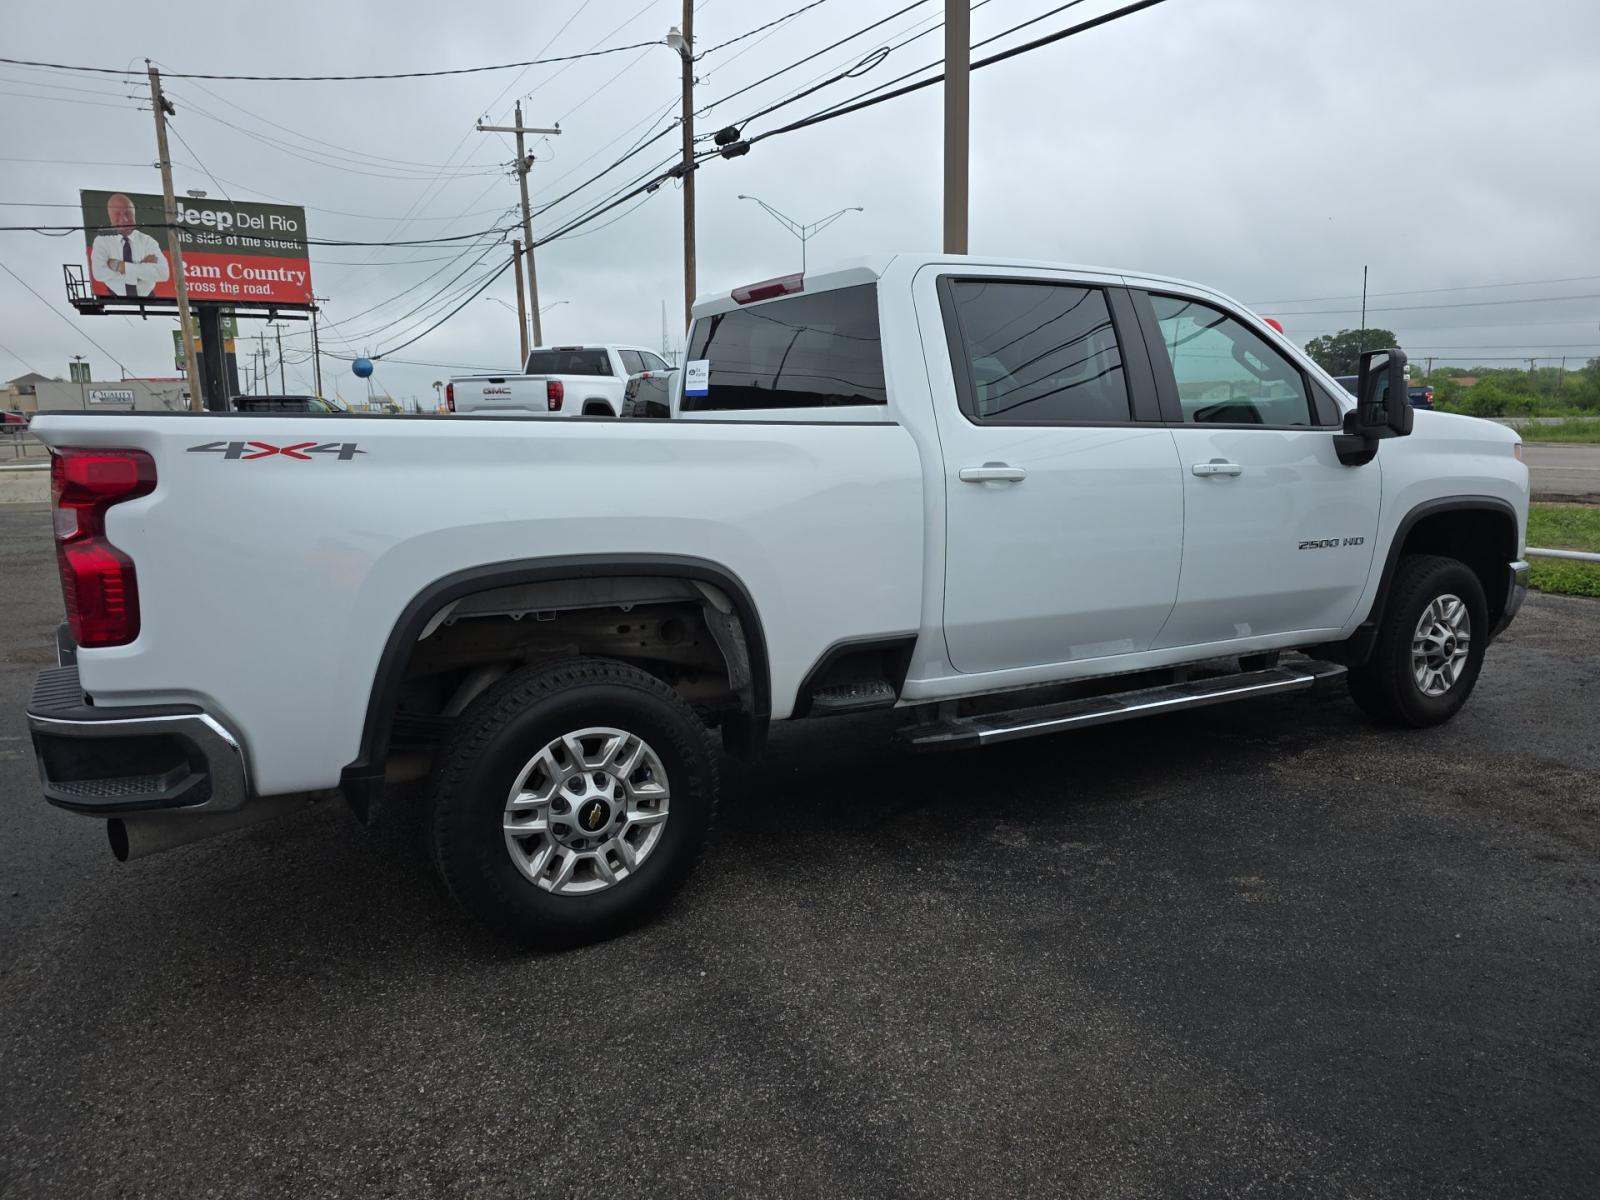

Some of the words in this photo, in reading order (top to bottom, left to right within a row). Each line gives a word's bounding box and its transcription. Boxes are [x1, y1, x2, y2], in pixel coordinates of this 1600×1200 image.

[176, 202, 233, 231] Jeep
[236, 212, 265, 230] Del
[269, 215, 298, 232] Rio
[196, 232, 223, 245] side
[226, 235, 239, 246] of
[241, 235, 261, 247] the
[226, 262, 306, 287] Country
[185, 281, 217, 293] cross
[220, 281, 240, 295] the
[243, 284, 275, 296] road.
[482, 387, 512, 395] GMC
[1298, 538, 1340, 550] 2500
[1343, 536, 1365, 547] HD
